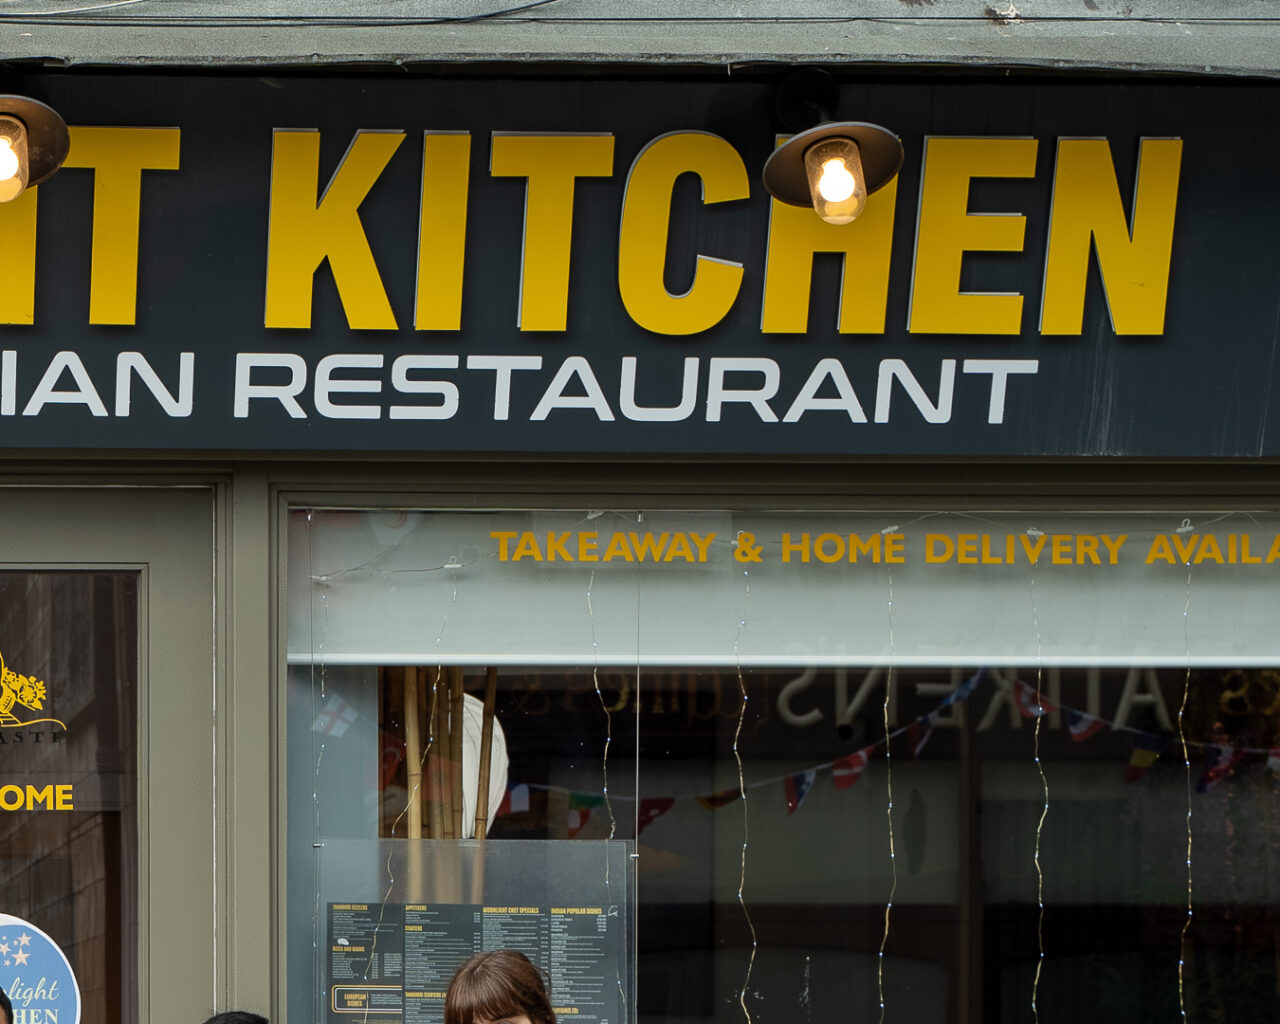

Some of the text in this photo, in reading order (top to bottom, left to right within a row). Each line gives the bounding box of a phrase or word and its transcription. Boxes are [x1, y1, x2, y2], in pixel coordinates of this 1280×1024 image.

[264, 128, 1184, 336] KITCHEN
[233, 352, 1039, 424] RESTAURANT
[489, 532, 717, 563] TAKEAWAY
[733, 532, 763, 563] &
[781, 533, 905, 564] HOME
[925, 533, 1128, 565] DELIVERY
[3, 976, 60, 1007] light
[12, 1008, 59, 1024] HEN
